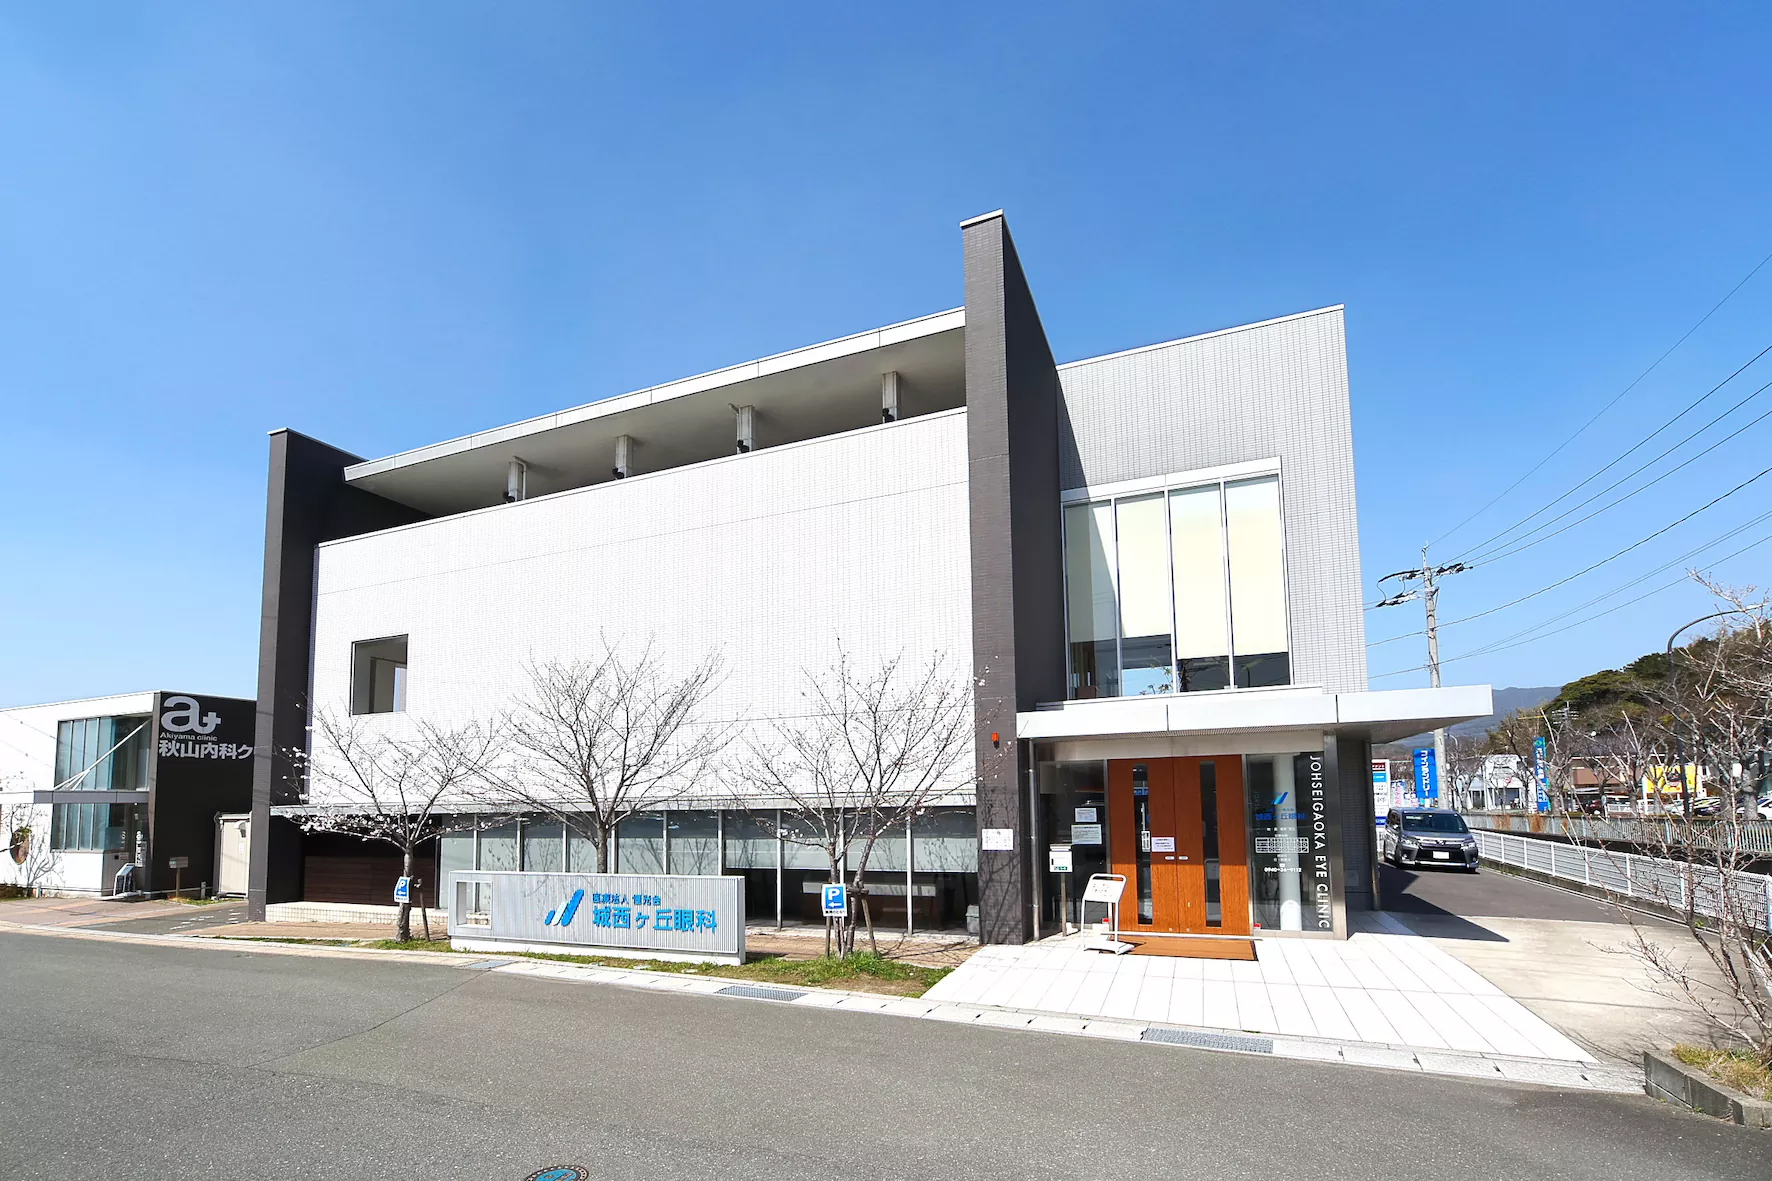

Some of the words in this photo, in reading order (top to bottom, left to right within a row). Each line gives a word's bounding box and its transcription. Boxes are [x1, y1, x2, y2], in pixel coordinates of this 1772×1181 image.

[160, 732, 196, 740] Akiyama
[159, 740, 254, 760] 秋山内科ク
[1310, 755, 1326, 850] JOHSEIGAOKA
[1315, 855, 1328, 878] EYE
[828, 888, 841, 901] P
[1316, 884, 1331, 929] CLINIC
[592, 906, 717, 933] 城西ヶ丘眼科
